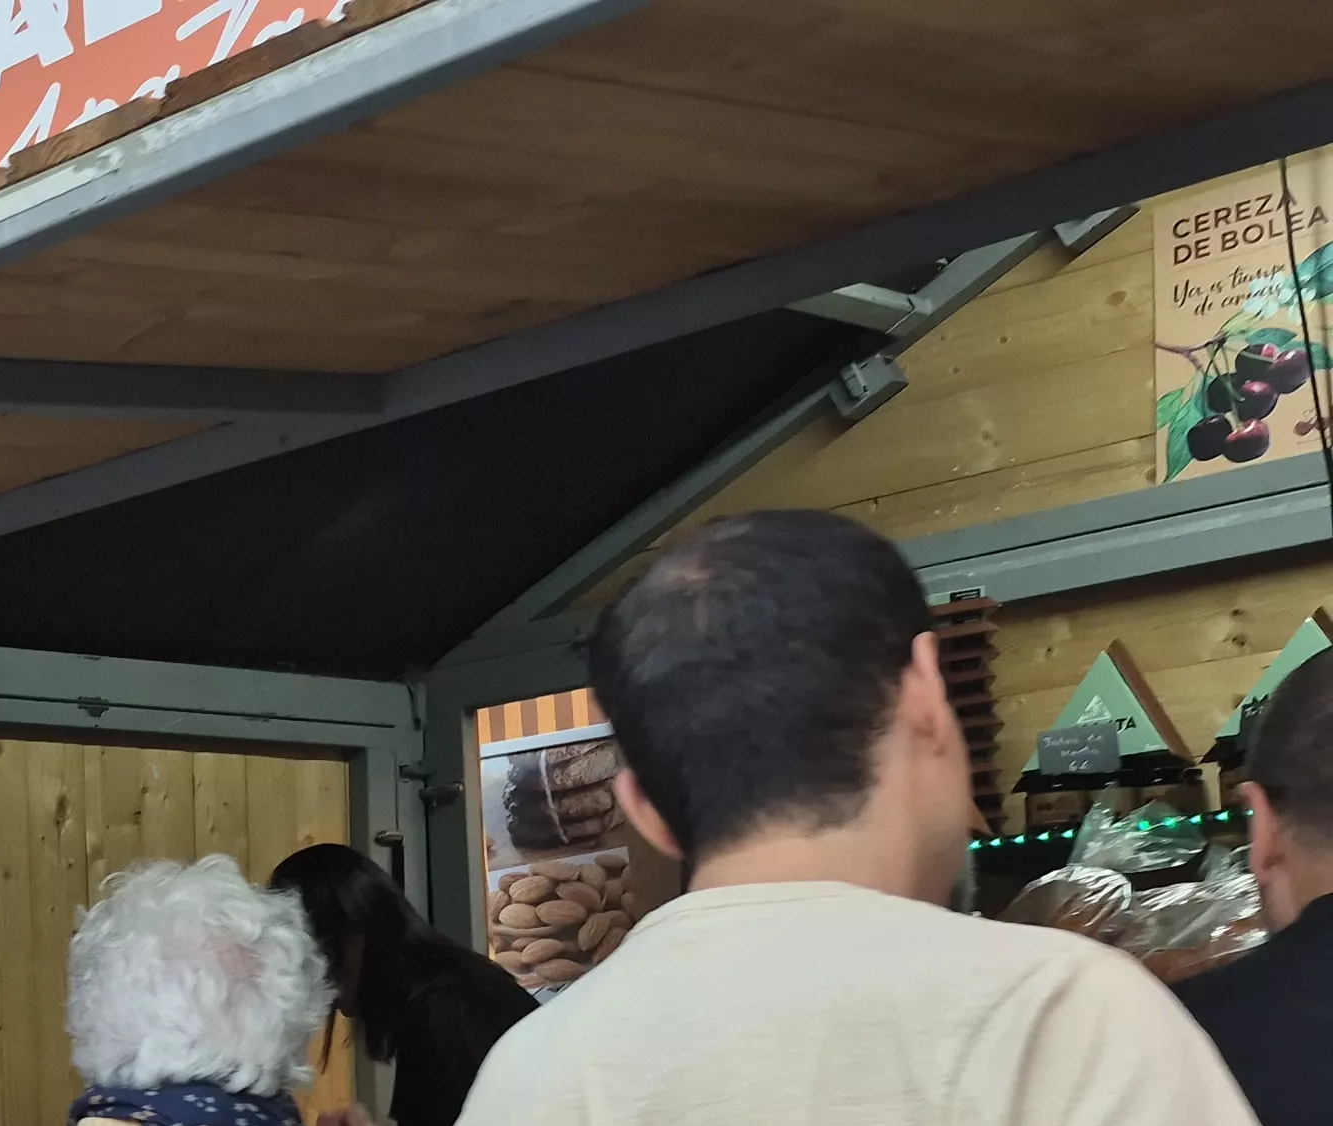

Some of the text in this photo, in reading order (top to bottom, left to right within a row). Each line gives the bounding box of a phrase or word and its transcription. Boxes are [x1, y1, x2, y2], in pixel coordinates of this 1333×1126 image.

[1172, 190, 1297, 239] CEREZA
[1173, 205, 1329, 266] DE BOLEA
[1173, 279, 1204, 308] Ya
[1210, 280, 1226, 295] es
[1194, 295, 1215, 316] de
